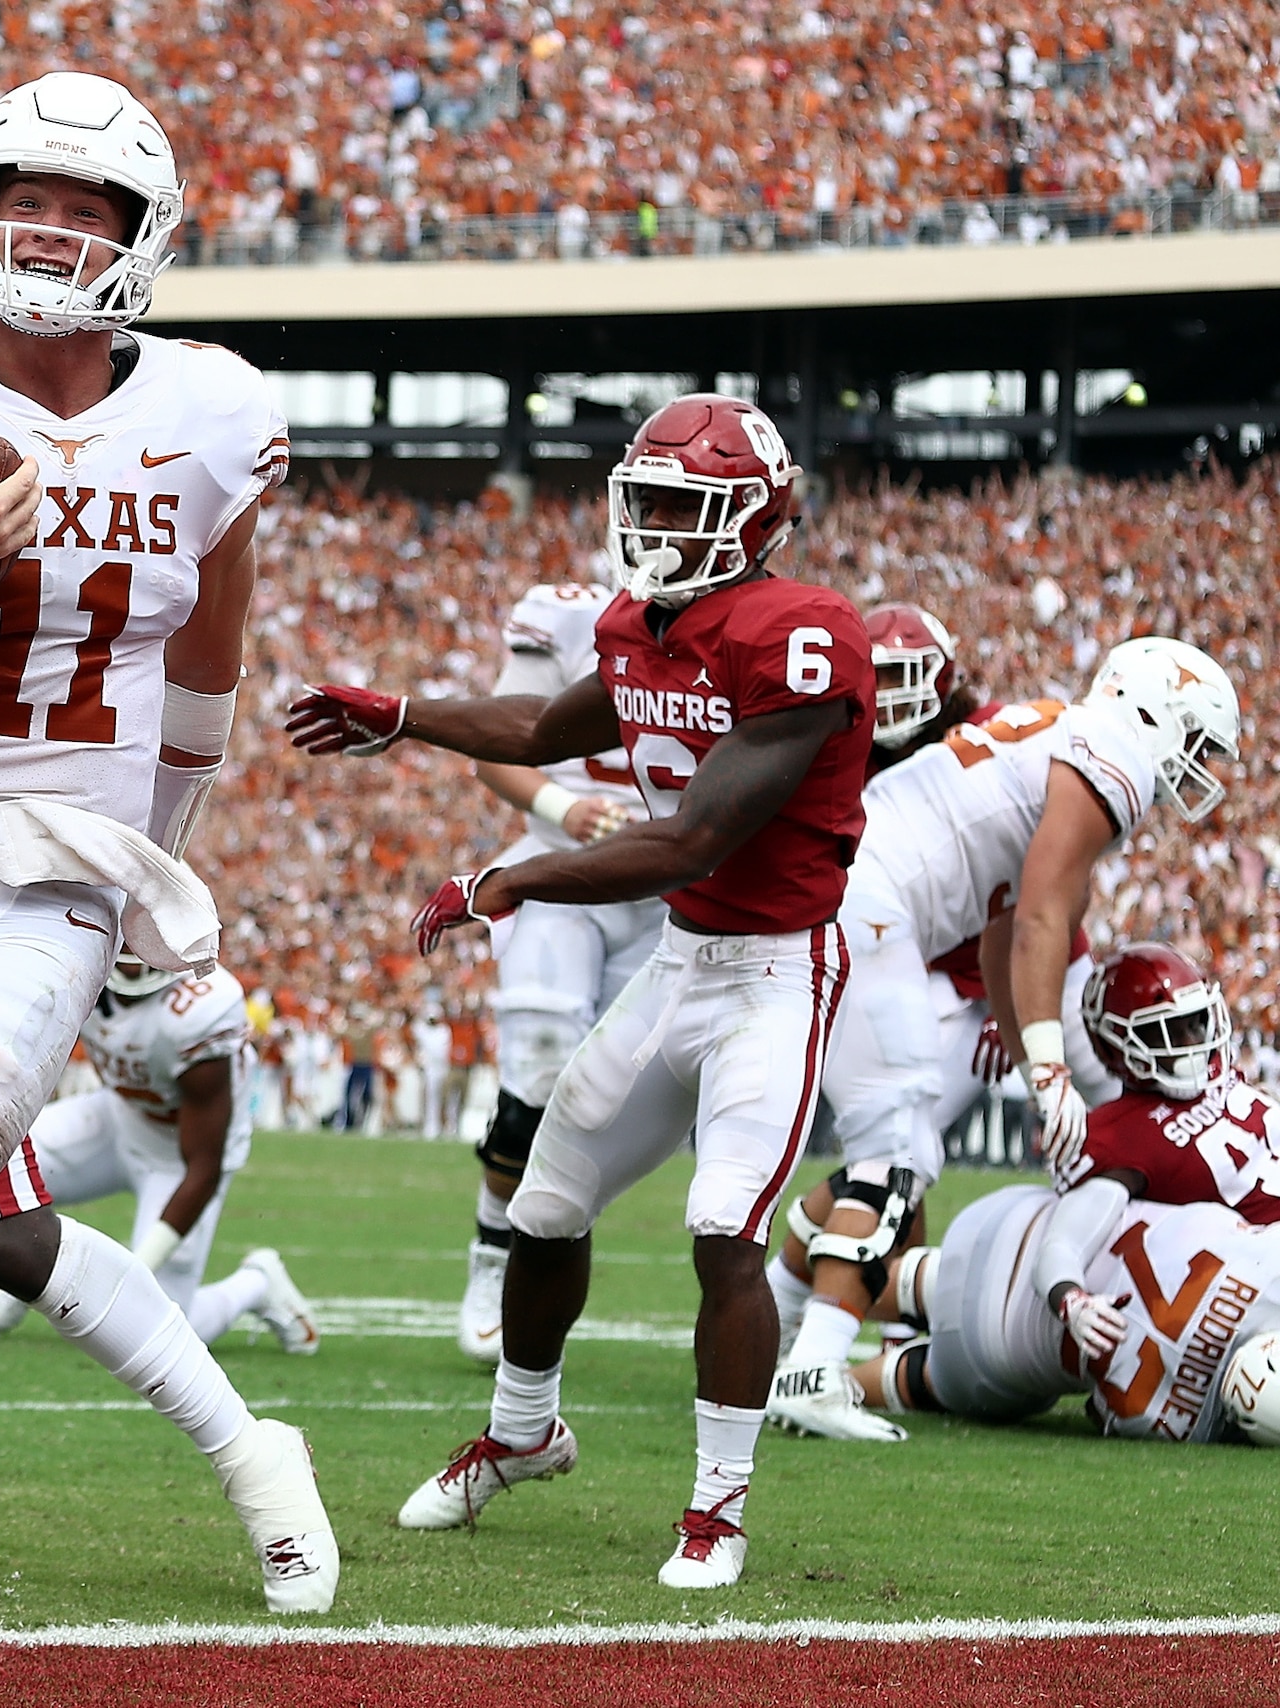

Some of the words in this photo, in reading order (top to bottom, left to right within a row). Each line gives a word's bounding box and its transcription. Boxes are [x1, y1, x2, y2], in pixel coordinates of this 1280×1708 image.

[24, 486, 181, 556] XAS
[785, 626, 834, 695] 6
[776, 1367, 827, 1397] NIKE
[1151, 1275, 1260, 1441] RODRIGUEZ
[1231, 1367, 1266, 1412] 72
